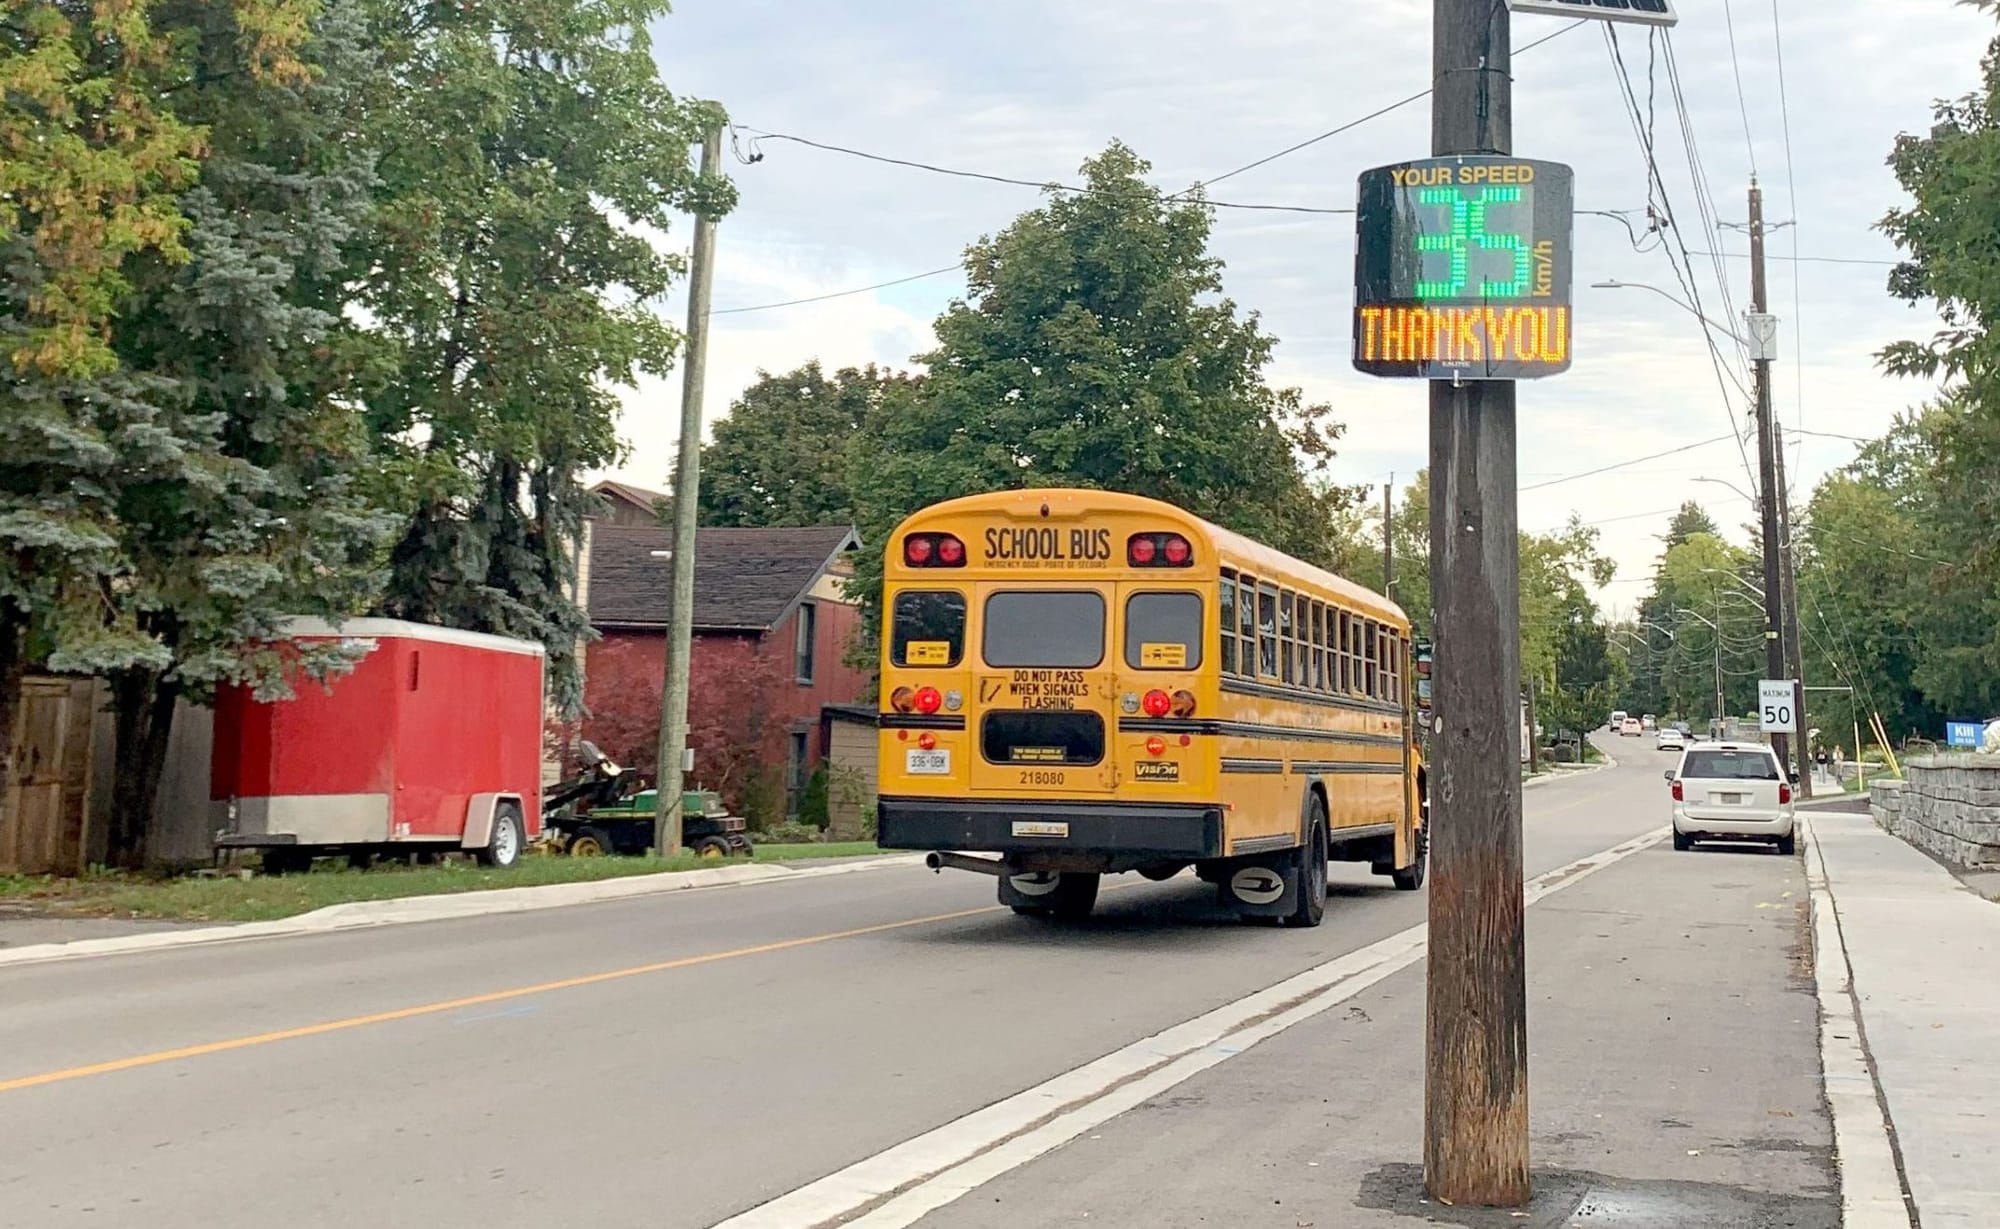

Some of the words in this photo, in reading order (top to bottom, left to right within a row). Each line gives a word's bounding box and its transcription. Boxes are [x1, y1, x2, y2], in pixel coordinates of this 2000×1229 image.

[1391, 168, 1452, 186] YOUR
[1459, 165, 1534, 184] SPEED
[1415, 187, 1529, 297] 35
[1533, 240, 1552, 297] km/h
[1361, 306, 1482, 362] THANK
[1485, 306, 1567, 363] YOU
[985, 528, 1065, 559] SCHOOL
[1070, 528, 1111, 560] BUS
[1014, 670, 1029, 682] DO
[1032, 670, 1052, 682] NOT
[1056, 671, 1084, 683] PASS
[1010, 683, 1039, 695] WHEN
[1043, 683, 1089, 696] SIGNALS
[1762, 689, 1791, 698] MAXIMUM
[1023, 696, 1074, 710] FLASHING
[1765, 705, 1790, 724] 50
[1020, 771, 1065, 785] 218080
